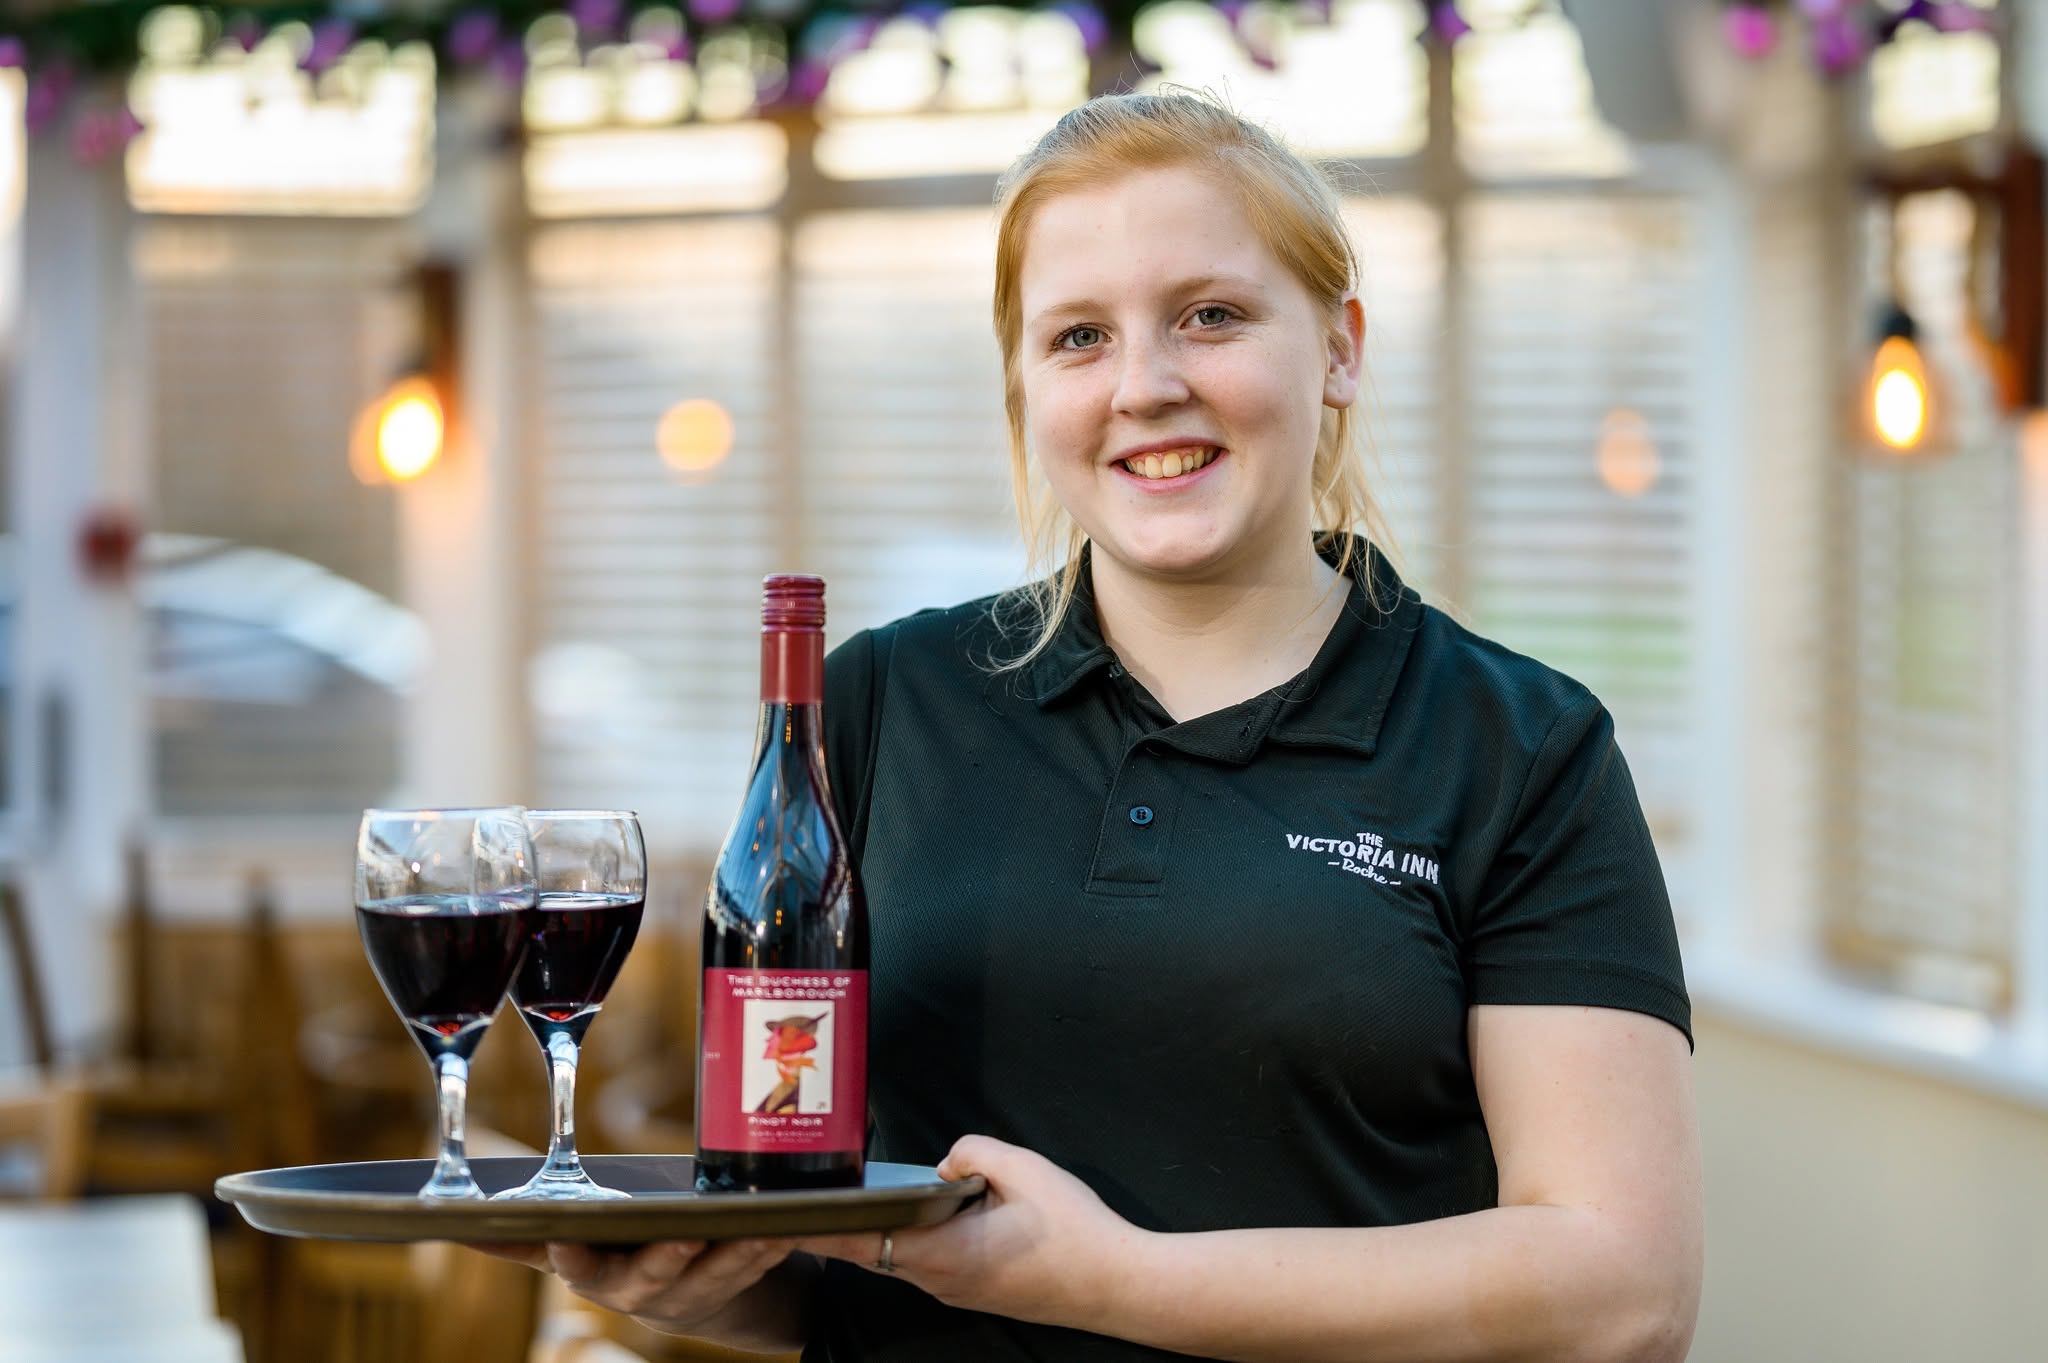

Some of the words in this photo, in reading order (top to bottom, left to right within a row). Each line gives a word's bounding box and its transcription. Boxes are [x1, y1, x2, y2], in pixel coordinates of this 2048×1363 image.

[1356, 832, 1384, 848] THE
[1285, 833, 1396, 869] VICTORIA
[1401, 853, 1439, 885] INN
[727, 974, 754, 986] THE
[759, 976, 830, 987] DUCHESS
[833, 976, 851, 987] OF
[732, 987, 847, 999] MARLBOROUGH
[748, 1116, 787, 1127] PINOT
[791, 1117, 823, 1127] NOIR
